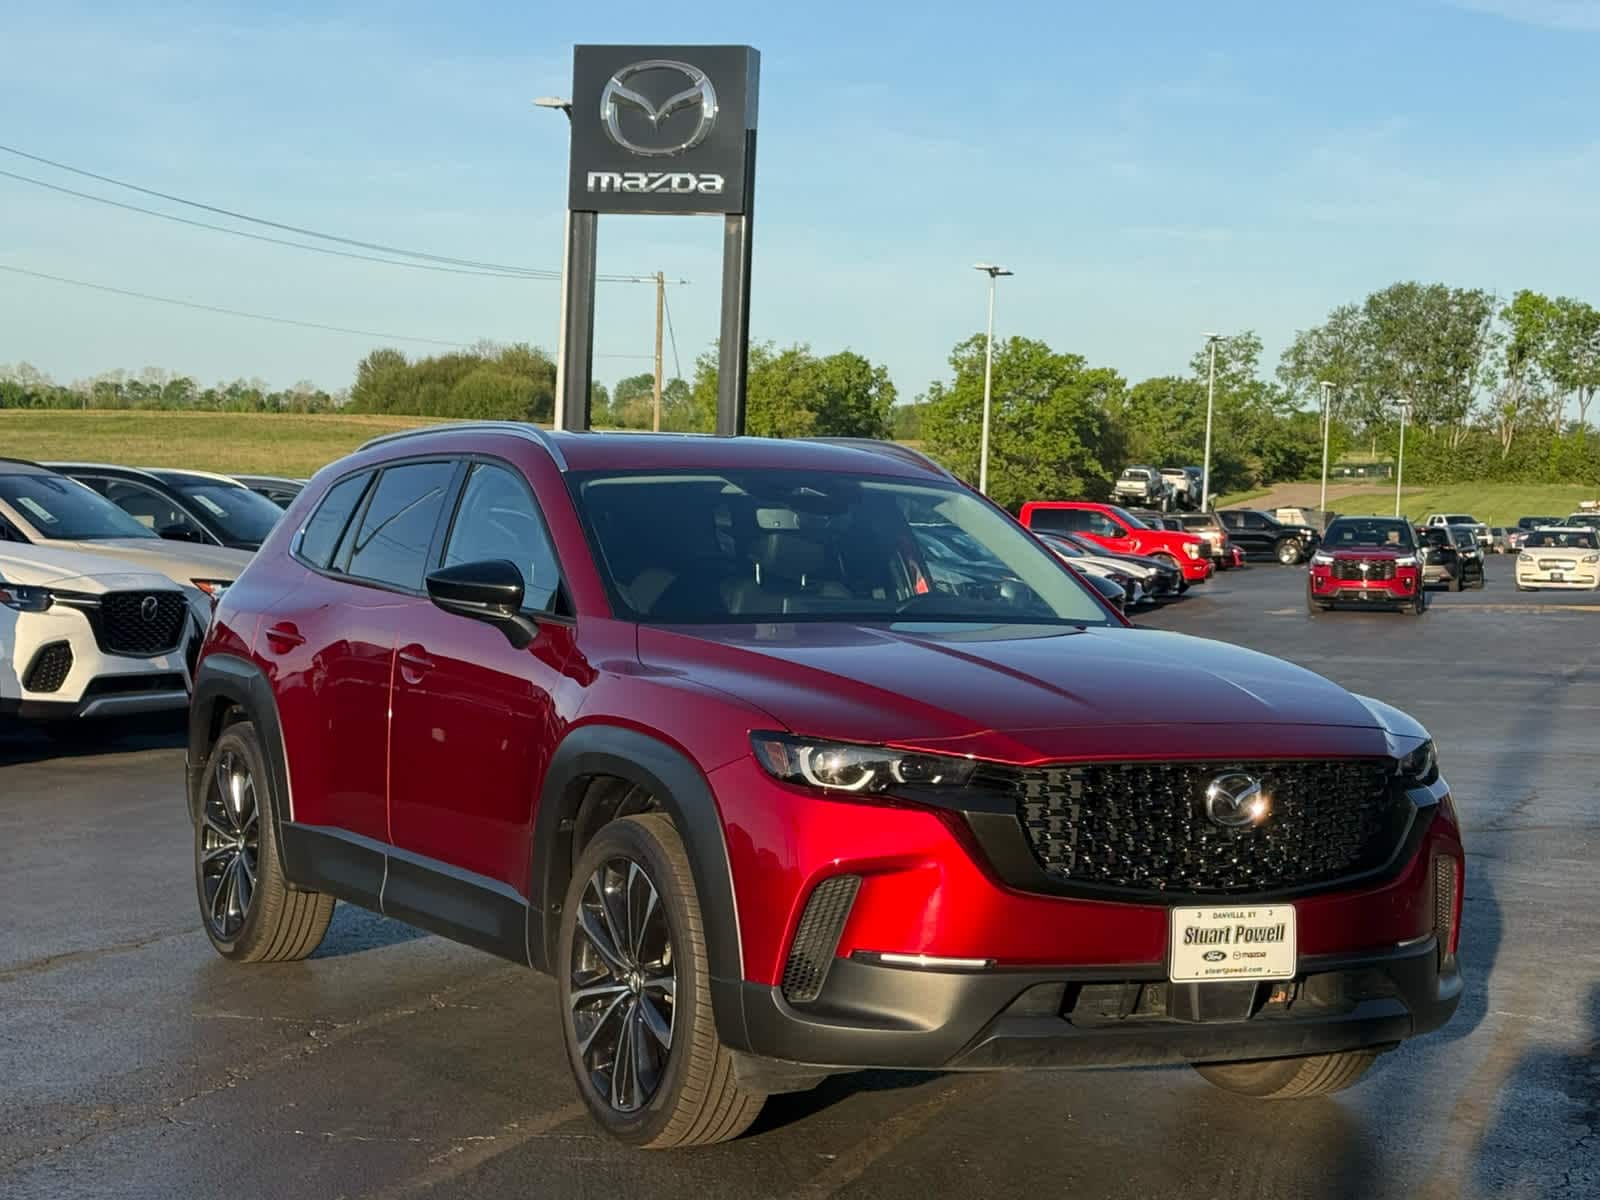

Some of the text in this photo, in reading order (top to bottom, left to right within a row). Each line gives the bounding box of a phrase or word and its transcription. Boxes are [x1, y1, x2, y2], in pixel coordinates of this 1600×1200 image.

[587, 171, 724, 193] mazda
[1212, 911, 1257, 920] DANVILLE, KY
[1184, 923, 1286, 945] Stuart Powell
